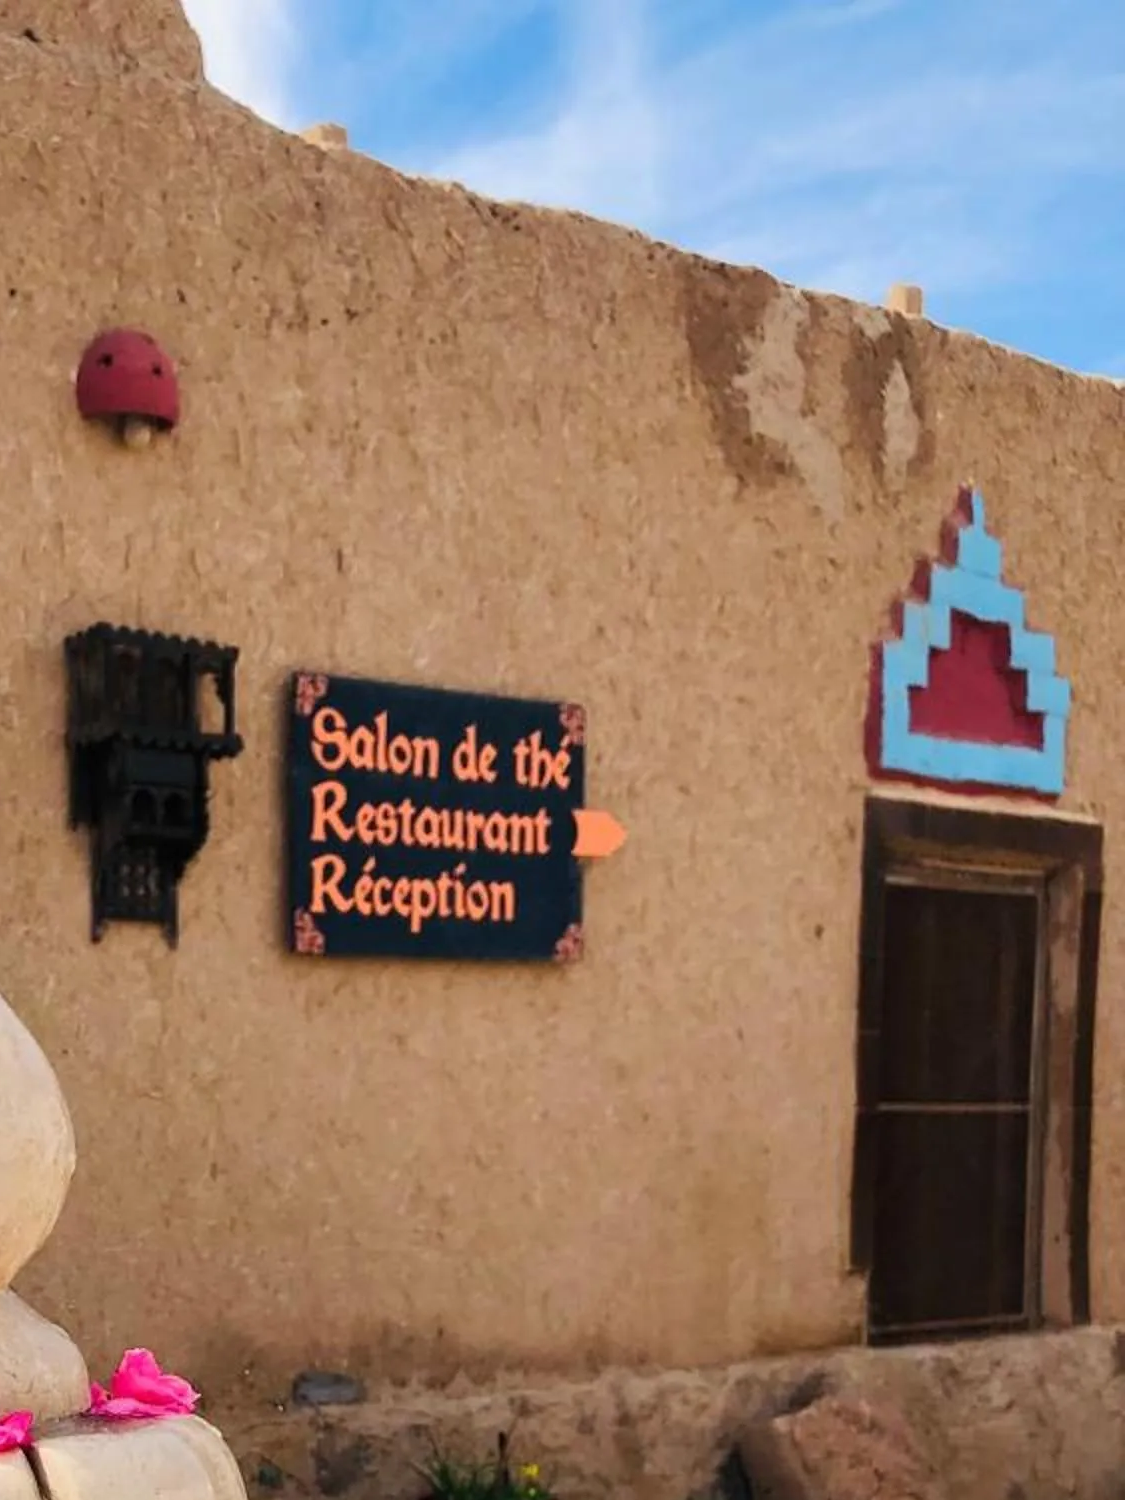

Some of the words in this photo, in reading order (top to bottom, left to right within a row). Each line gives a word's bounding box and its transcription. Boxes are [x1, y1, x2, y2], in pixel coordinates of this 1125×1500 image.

[311, 706, 439, 779] Salon
[452, 724, 498, 784] de
[513, 730, 571, 790] thé
[310, 781, 552, 855] Restaurant
[310, 854, 515, 934] Réception
